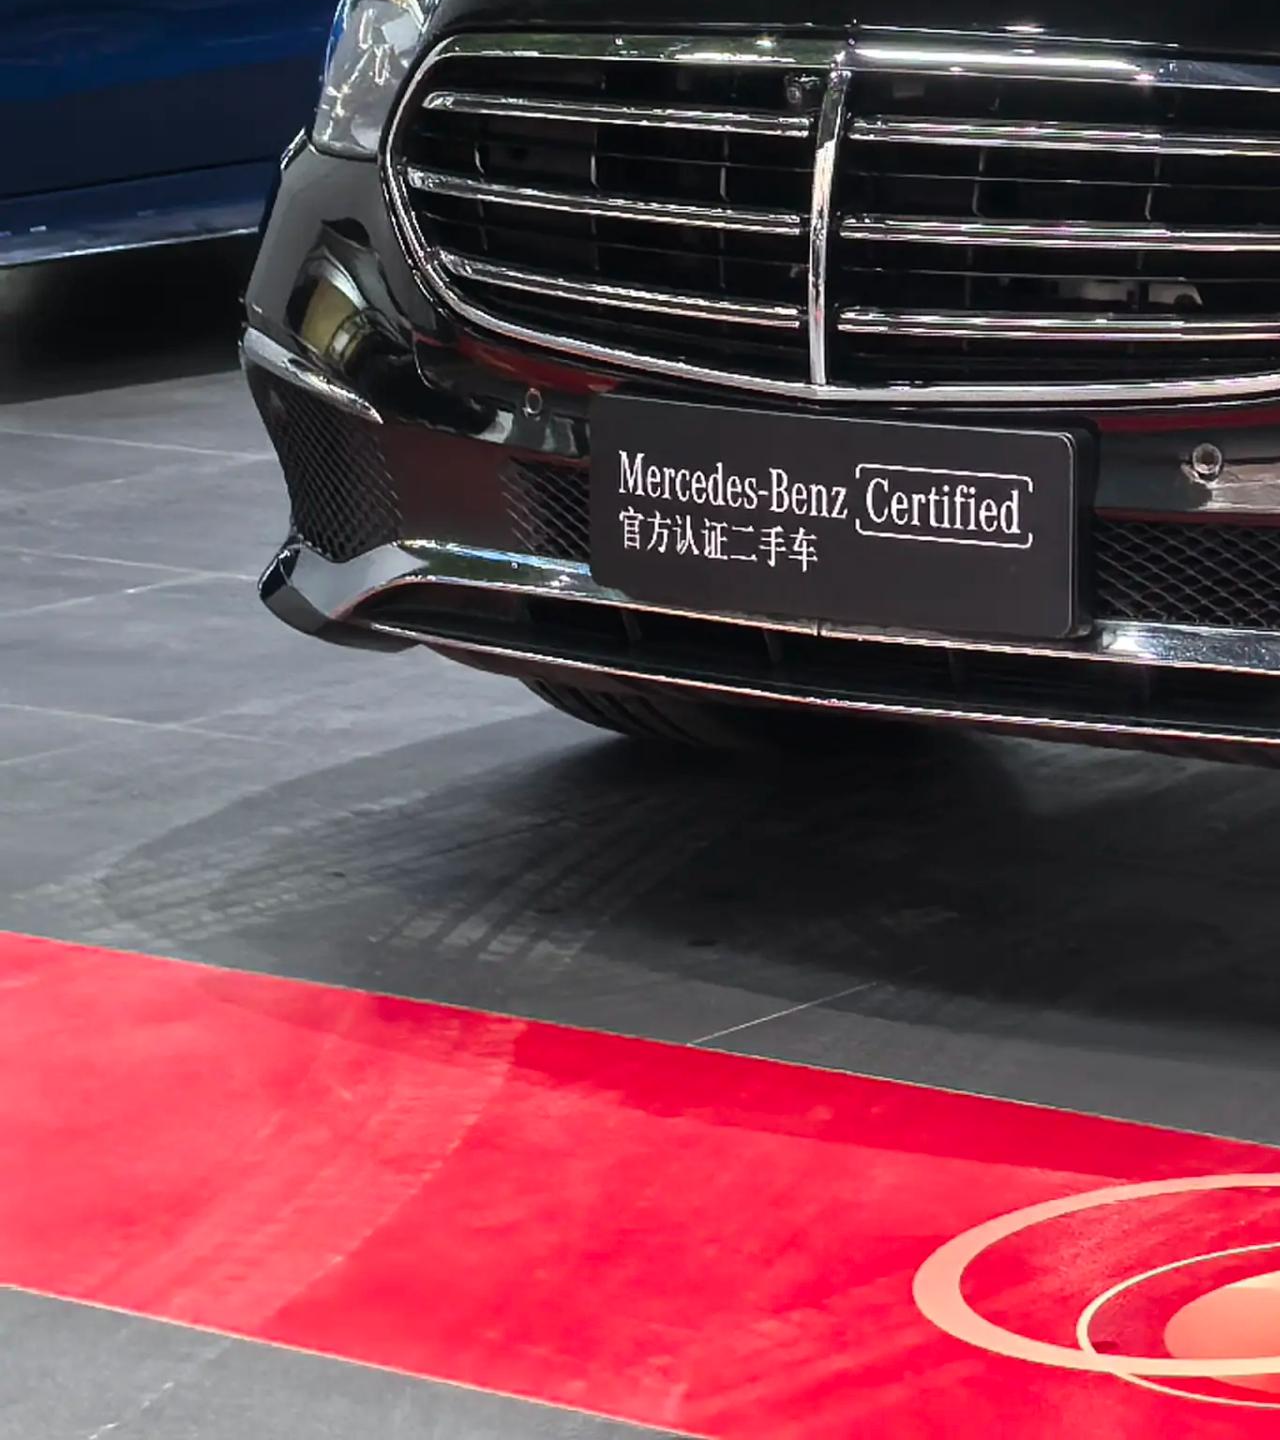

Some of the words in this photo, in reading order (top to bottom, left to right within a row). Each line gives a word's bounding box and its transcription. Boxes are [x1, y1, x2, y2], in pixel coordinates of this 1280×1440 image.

[618, 450, 848, 519] Mercedes-Benz
[865, 478, 1021, 534] Certified
[619, 506, 818, 572] 官方认证二手车
